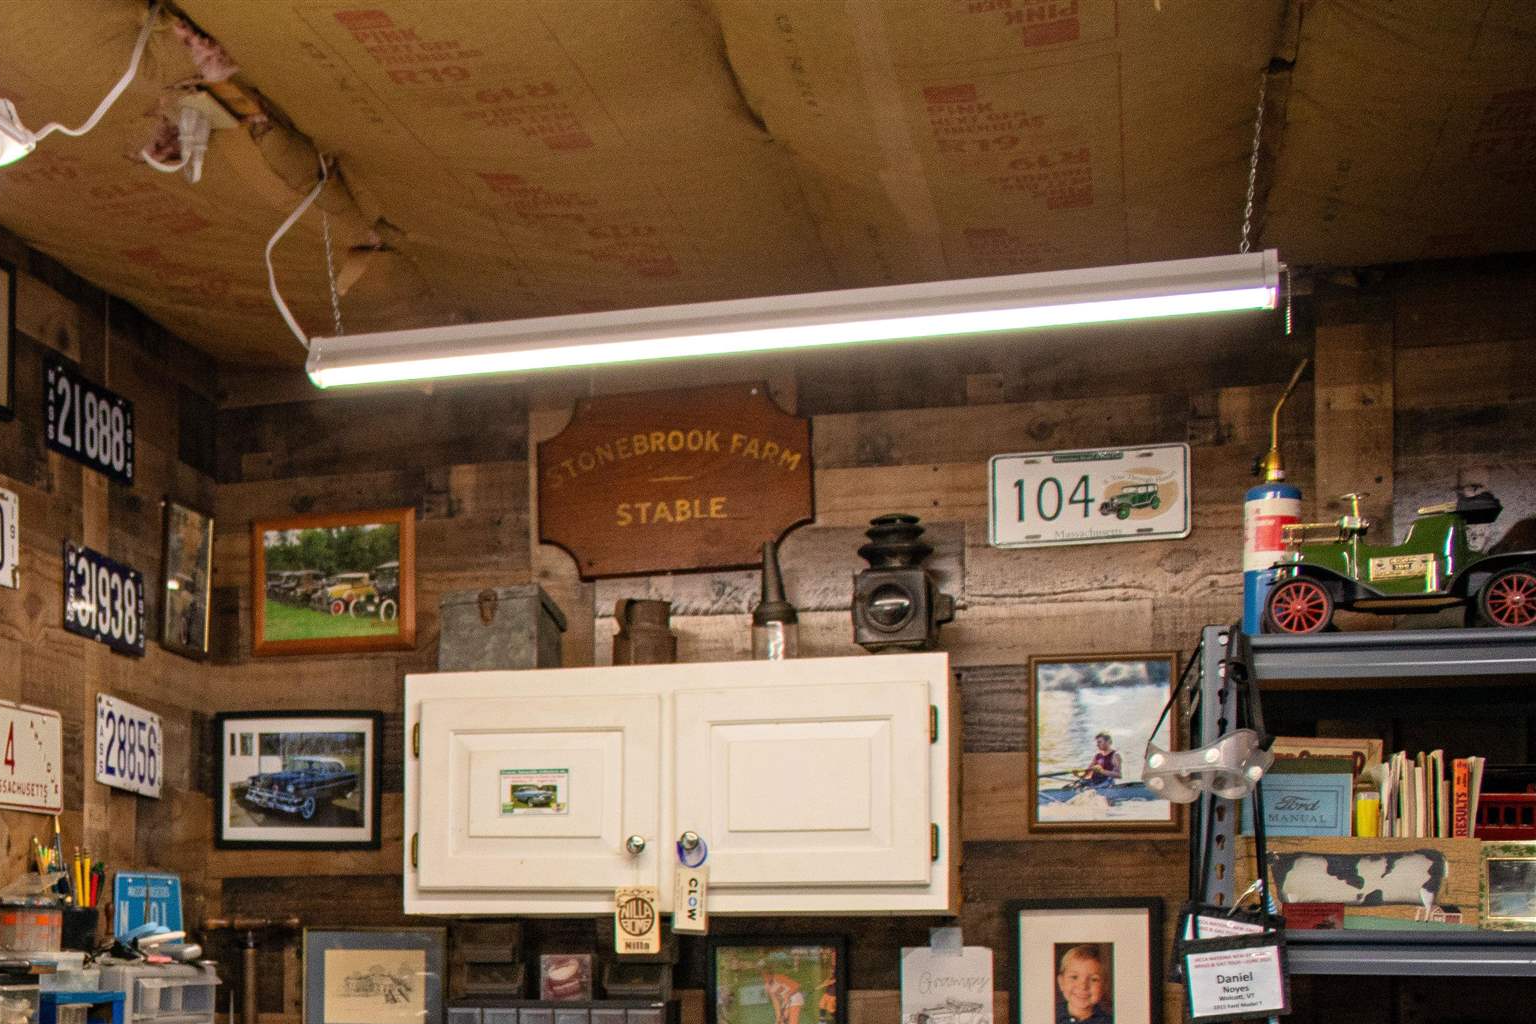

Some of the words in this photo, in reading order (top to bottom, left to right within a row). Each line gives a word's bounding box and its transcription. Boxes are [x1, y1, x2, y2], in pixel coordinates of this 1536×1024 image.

[57, 376, 125, 473] 21888
[729, 432, 802, 472] FARM
[616, 496, 729, 527] STABLE
[1013, 474, 1096, 523] 104
[4, 720, 15, 776] 4
[105, 709, 157, 787] 28856
[1268, 813, 1327, 824] MANUAL
[1274, 795, 1321, 812] Ford
[1456, 792, 1468, 837] RESULTS
[1217, 971, 1253, 985] Daniel
[1223, 985, 1250, 994] Noyes
